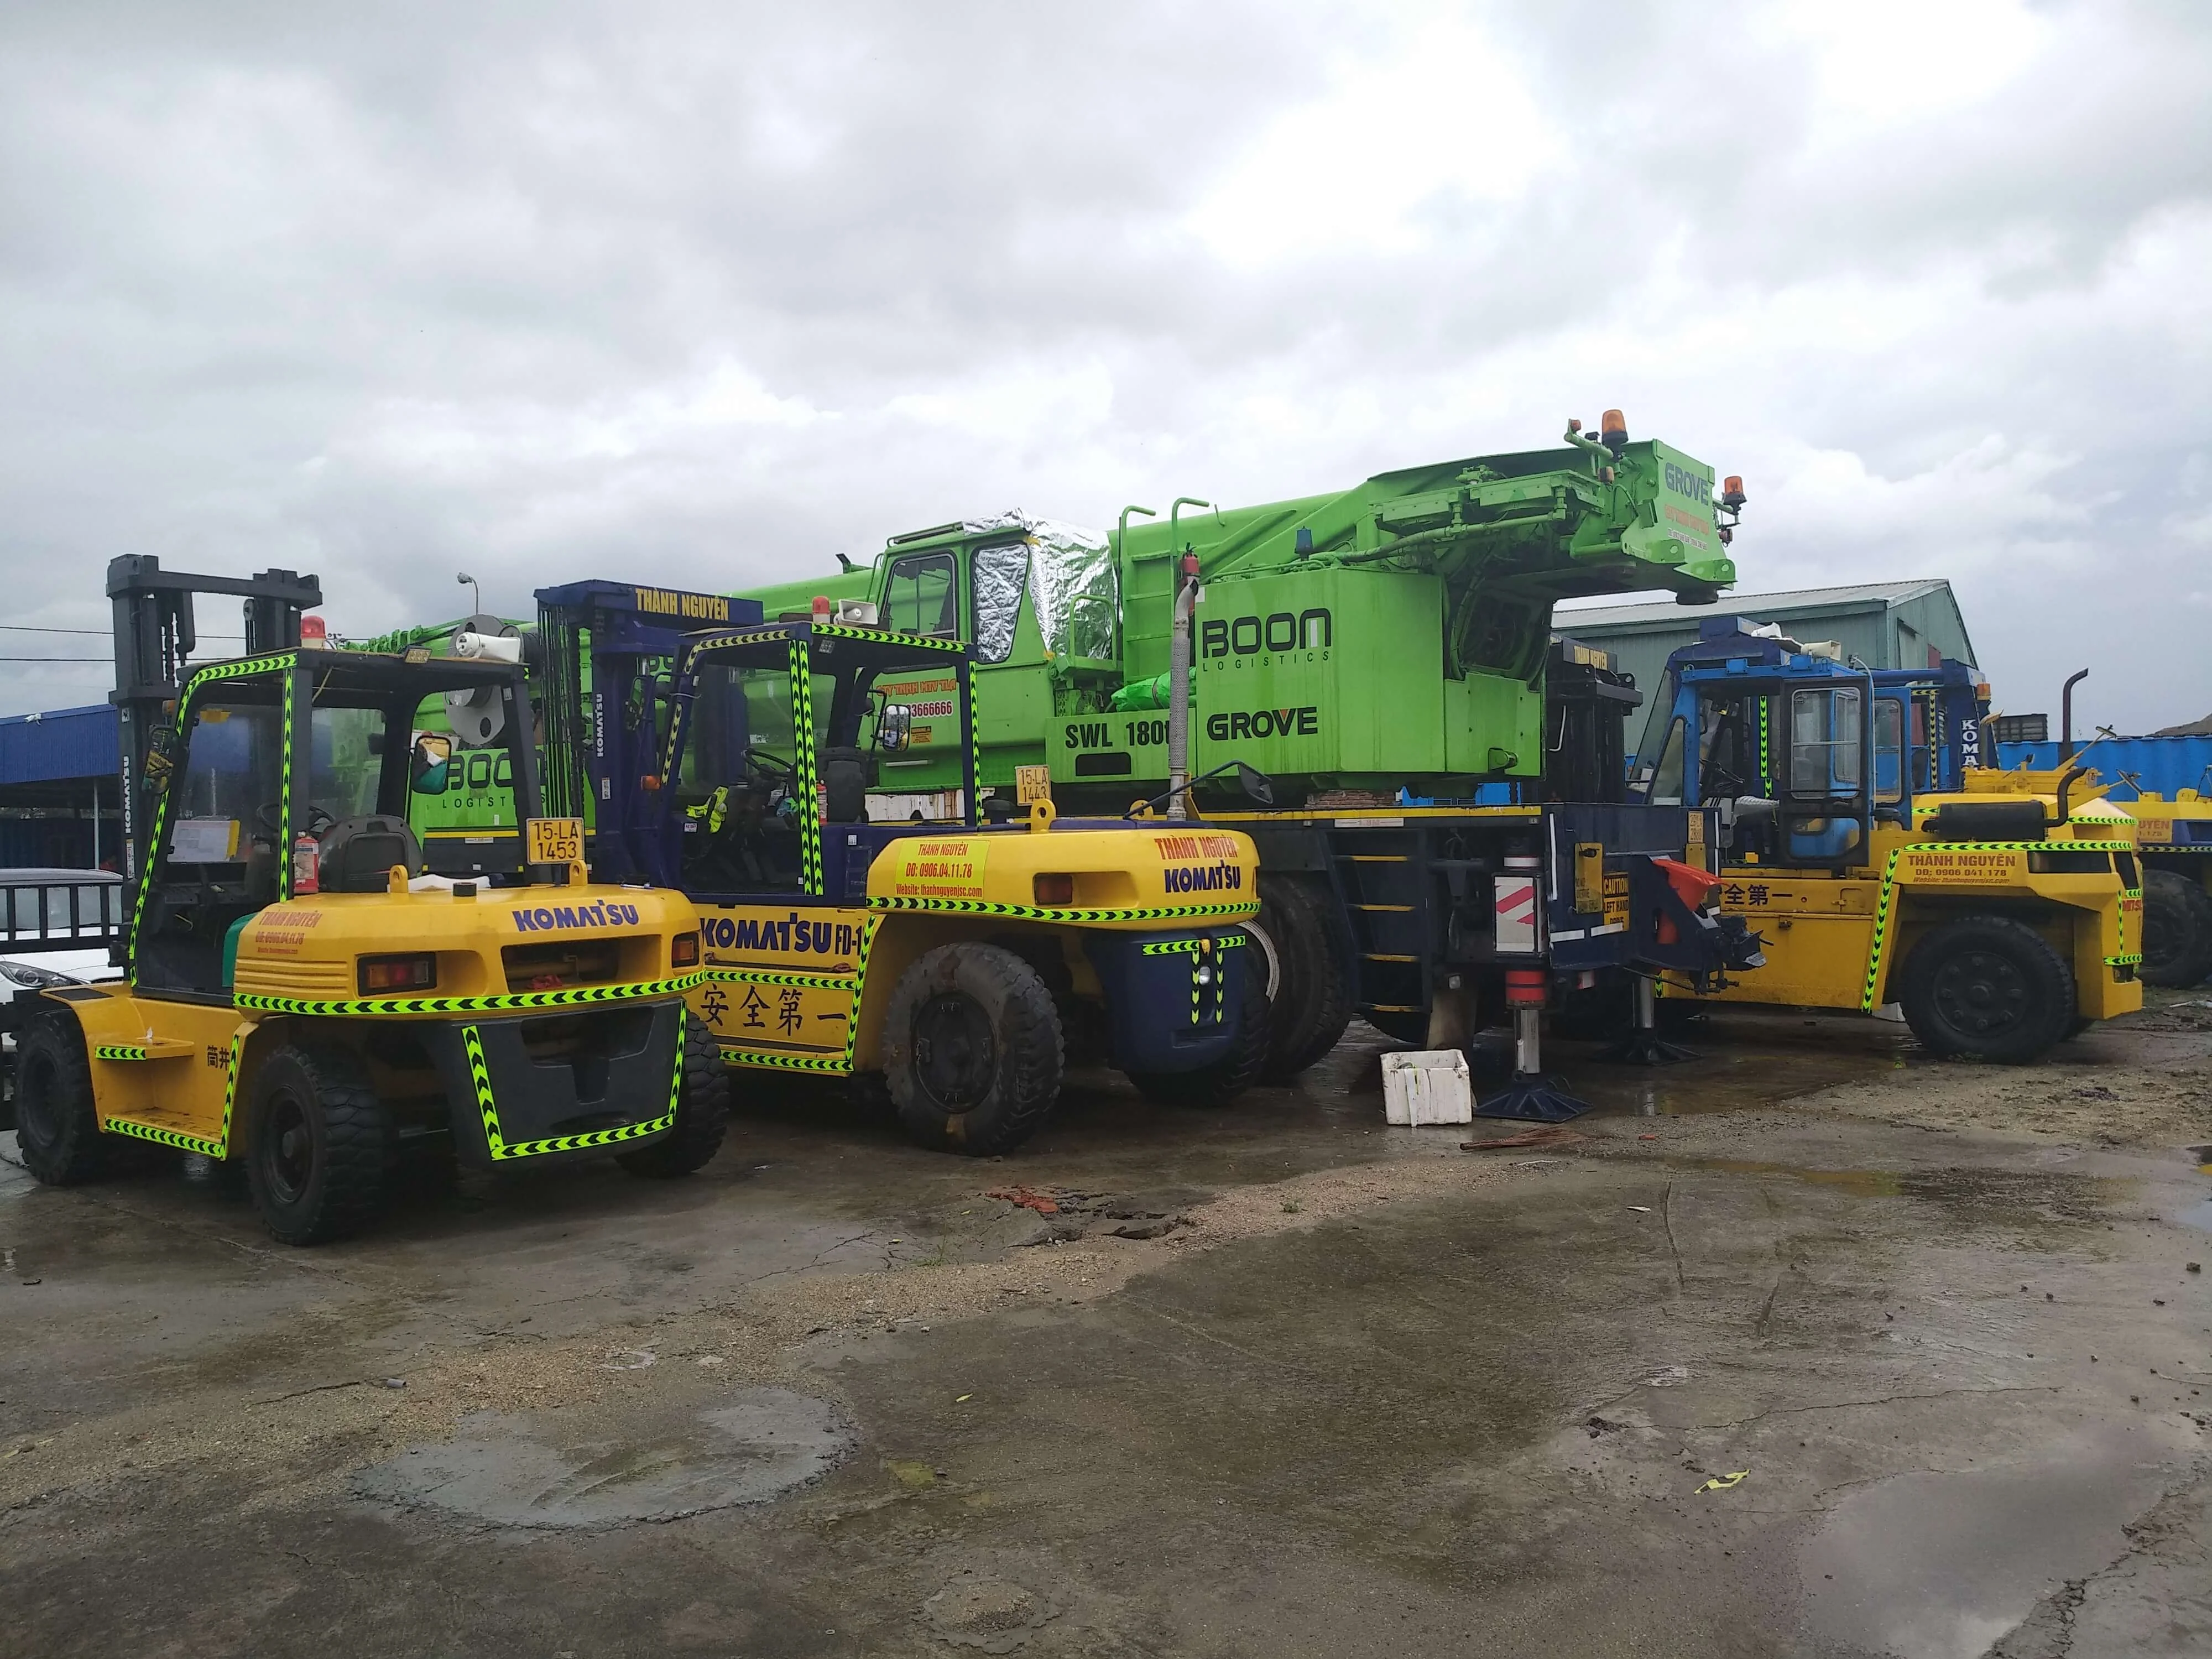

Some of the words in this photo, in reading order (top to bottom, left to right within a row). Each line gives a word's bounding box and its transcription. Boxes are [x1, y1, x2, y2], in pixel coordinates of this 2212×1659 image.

[1665, 462, 1709, 507] GROVE
[635, 588, 678, 615] THÀNH
[681, 594, 729, 622] NGUYÊN
[1202, 608, 1332, 658] BOOM
[1203, 650, 1329, 672] LOGISTICS
[1065, 723, 1113, 749] SWL
[1207, 707, 1318, 741] GROVE
[1961, 719, 1980, 766] KOMA
[123, 756, 132, 834] KOMATSU
[534, 821, 579, 841] 15-LA
[537, 841, 577, 860] 1453
[919, 842, 940, 856] THÀNH
[1154, 834, 1199, 860] THÀNH
[1908, 853, 1954, 867] THÀNH
[1958, 853, 2016, 867] NGUYÊN
[919, 862, 973, 879] 0906.04.11.78
[1164, 859, 1241, 893] KOMATSU
[896, 883, 920, 895] Website:
[1604, 878, 1629, 895] CAUTION
[1723, 883, 1793, 906] 全第一
[511, 899, 640, 932] KOMATSU
[1604, 901, 1615, 914] LEFT
[700, 912, 832, 953] KOMATSU
[834, 924, 863, 956] FD-1
[700, 983, 847, 1036] 安全第一
[207, 1044, 229, 1071] 筒井
